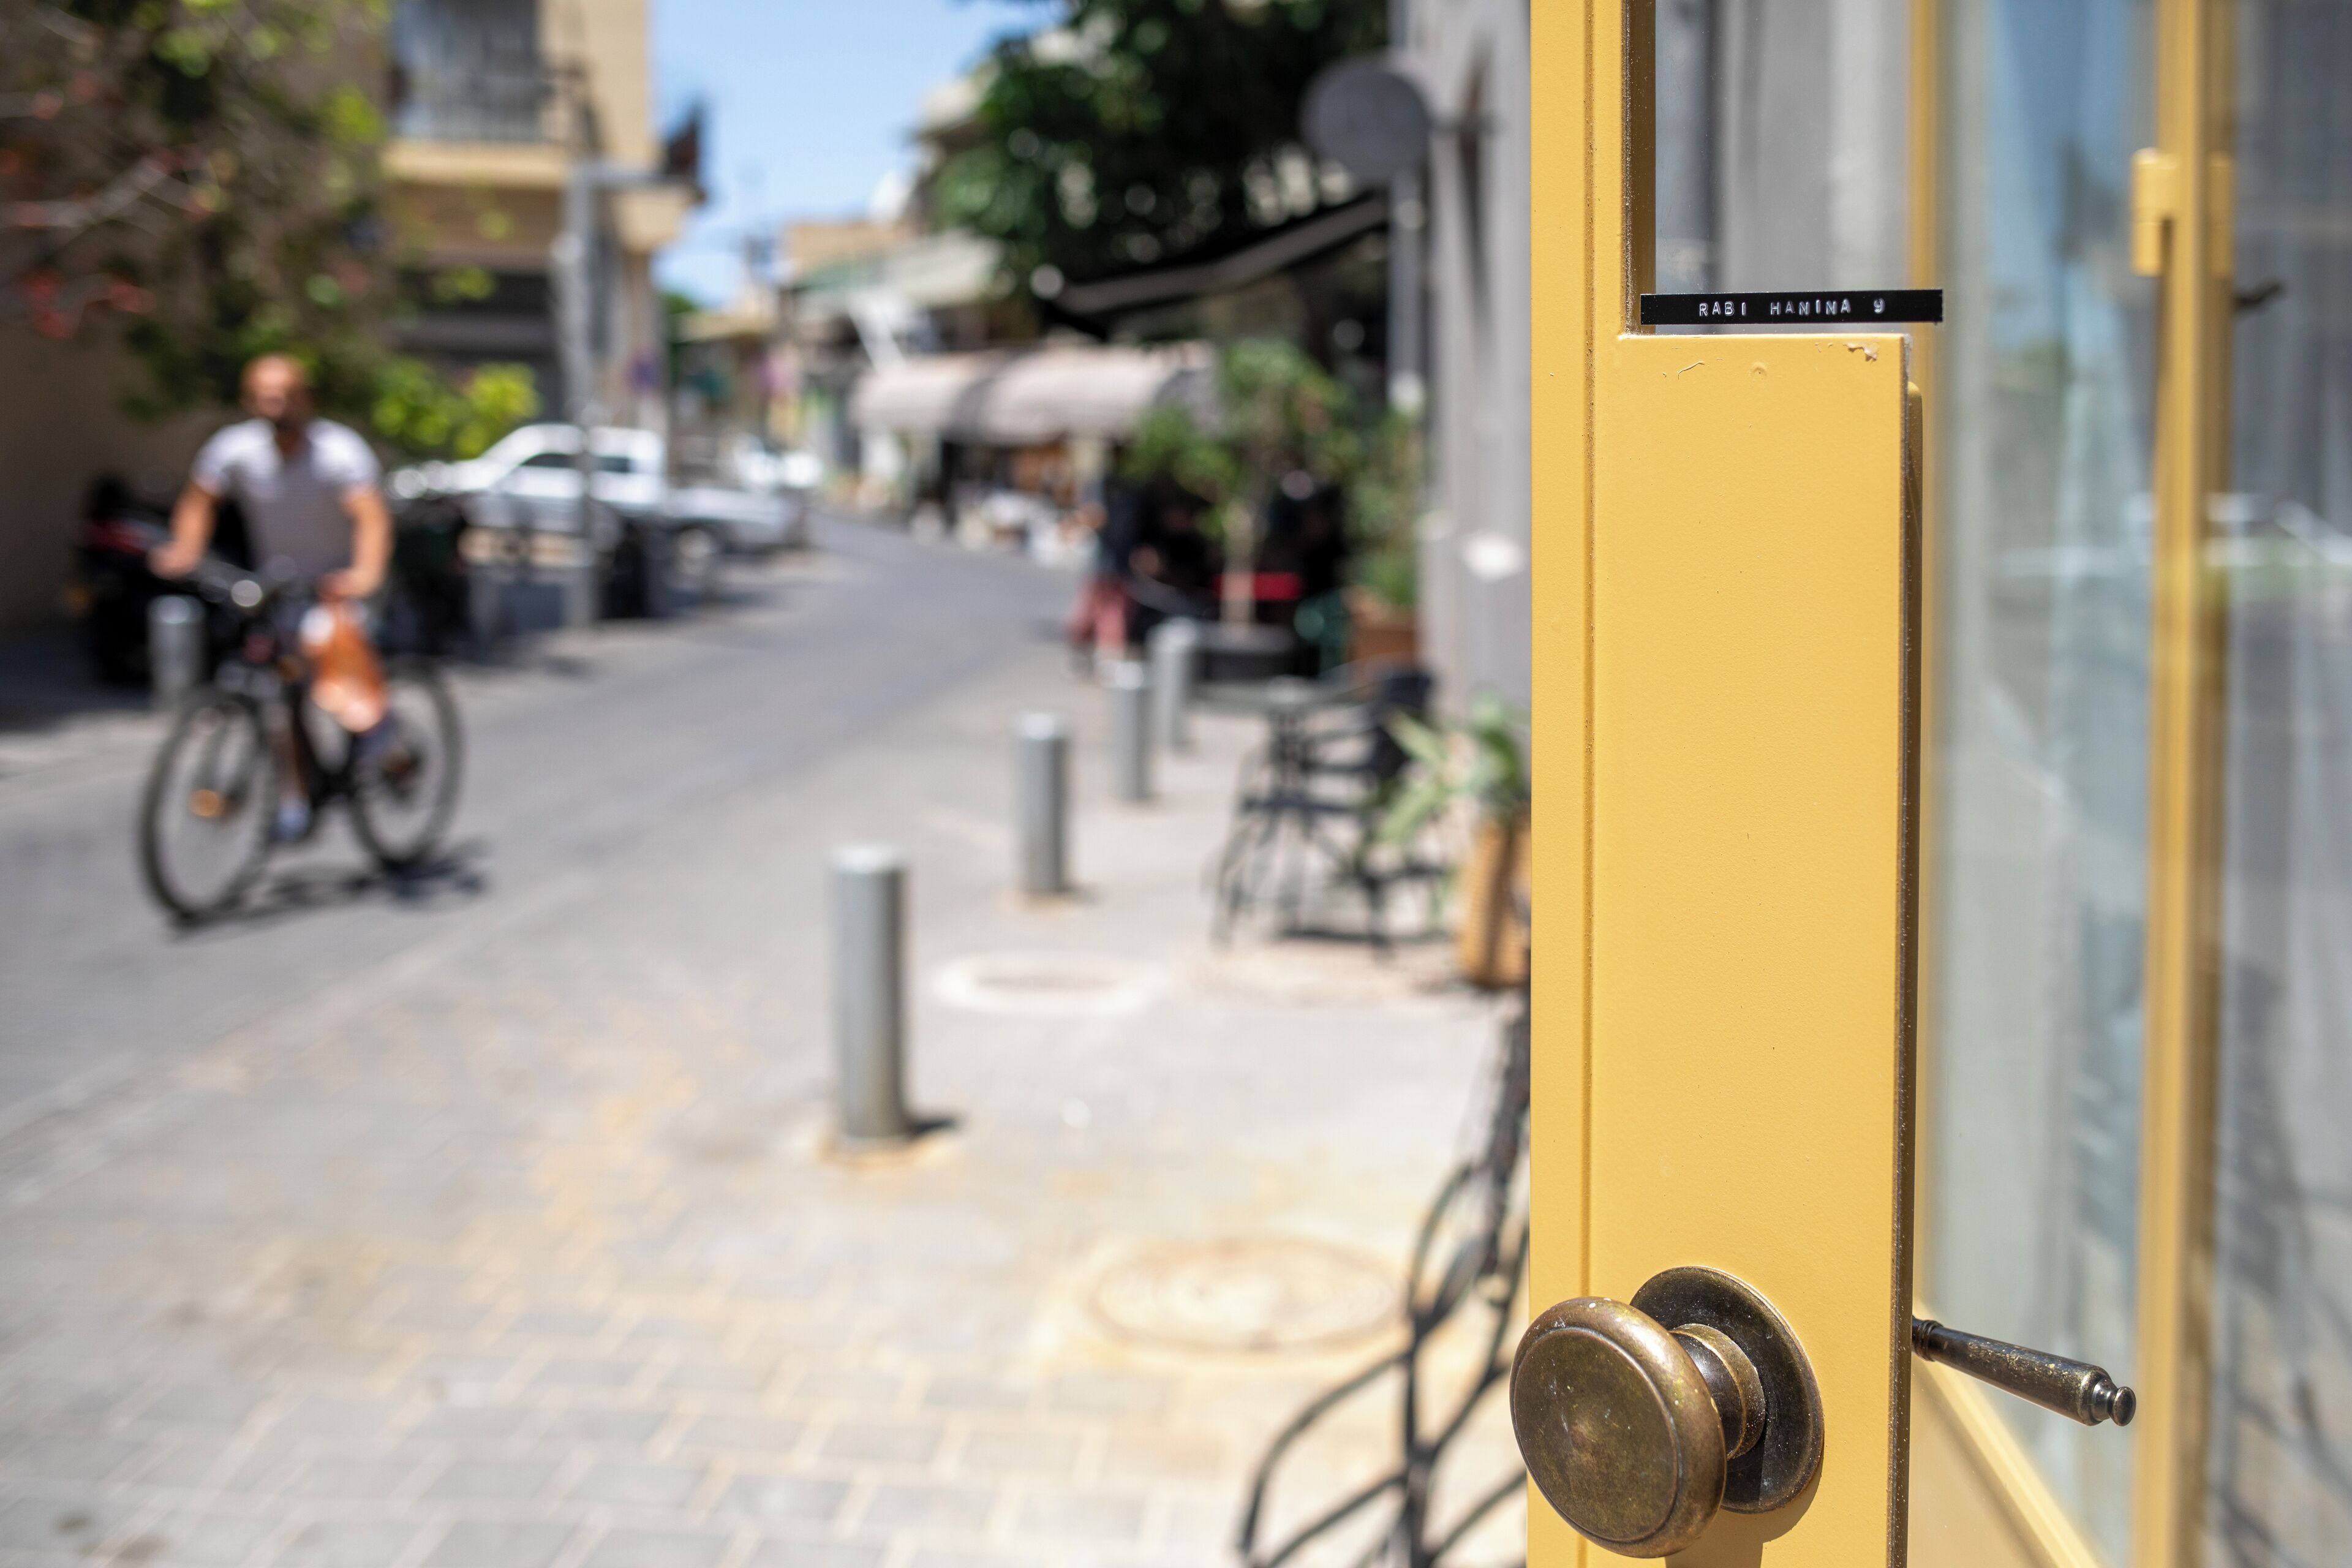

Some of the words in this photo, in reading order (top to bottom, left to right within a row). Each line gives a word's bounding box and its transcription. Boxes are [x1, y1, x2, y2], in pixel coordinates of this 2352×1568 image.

[1699, 301, 1746, 317] RABI
[1770, 298, 1852, 316] HANINA
[1873, 298, 1886, 314] 9
